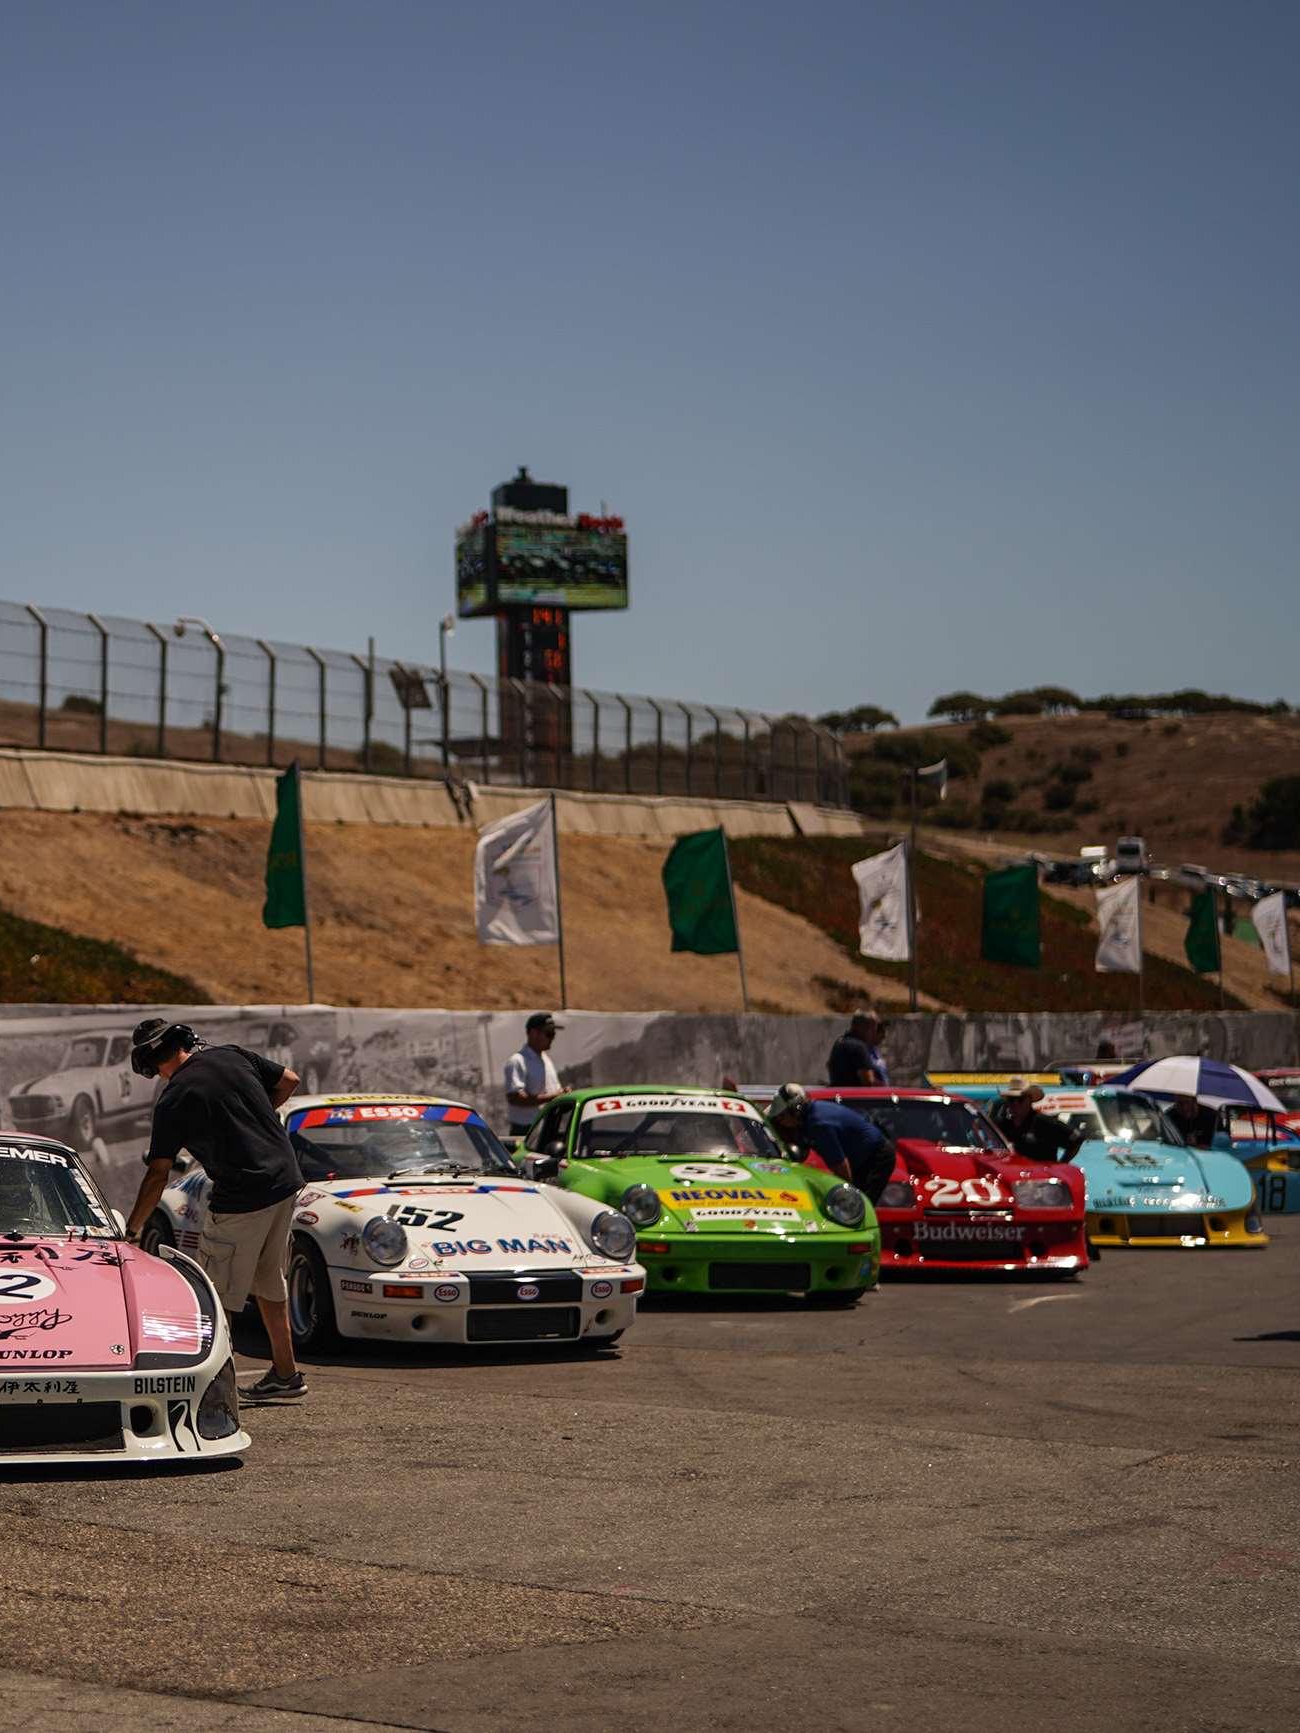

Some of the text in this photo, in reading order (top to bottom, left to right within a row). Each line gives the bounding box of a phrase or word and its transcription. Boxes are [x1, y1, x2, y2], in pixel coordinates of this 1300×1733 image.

[360, 1107, 419, 1118] ESSO
[684, 1165, 738, 1179] 52
[670, 1189, 772, 1202] NEOVAL
[924, 1178, 1002, 1208] 20
[1259, 1174, 1288, 1213] 18
[912, 1221, 1027, 1241] Budweiser
[351, 1310, 388, 1320] DUNLOP
[133, 1375, 196, 1395] BILSTEIN
